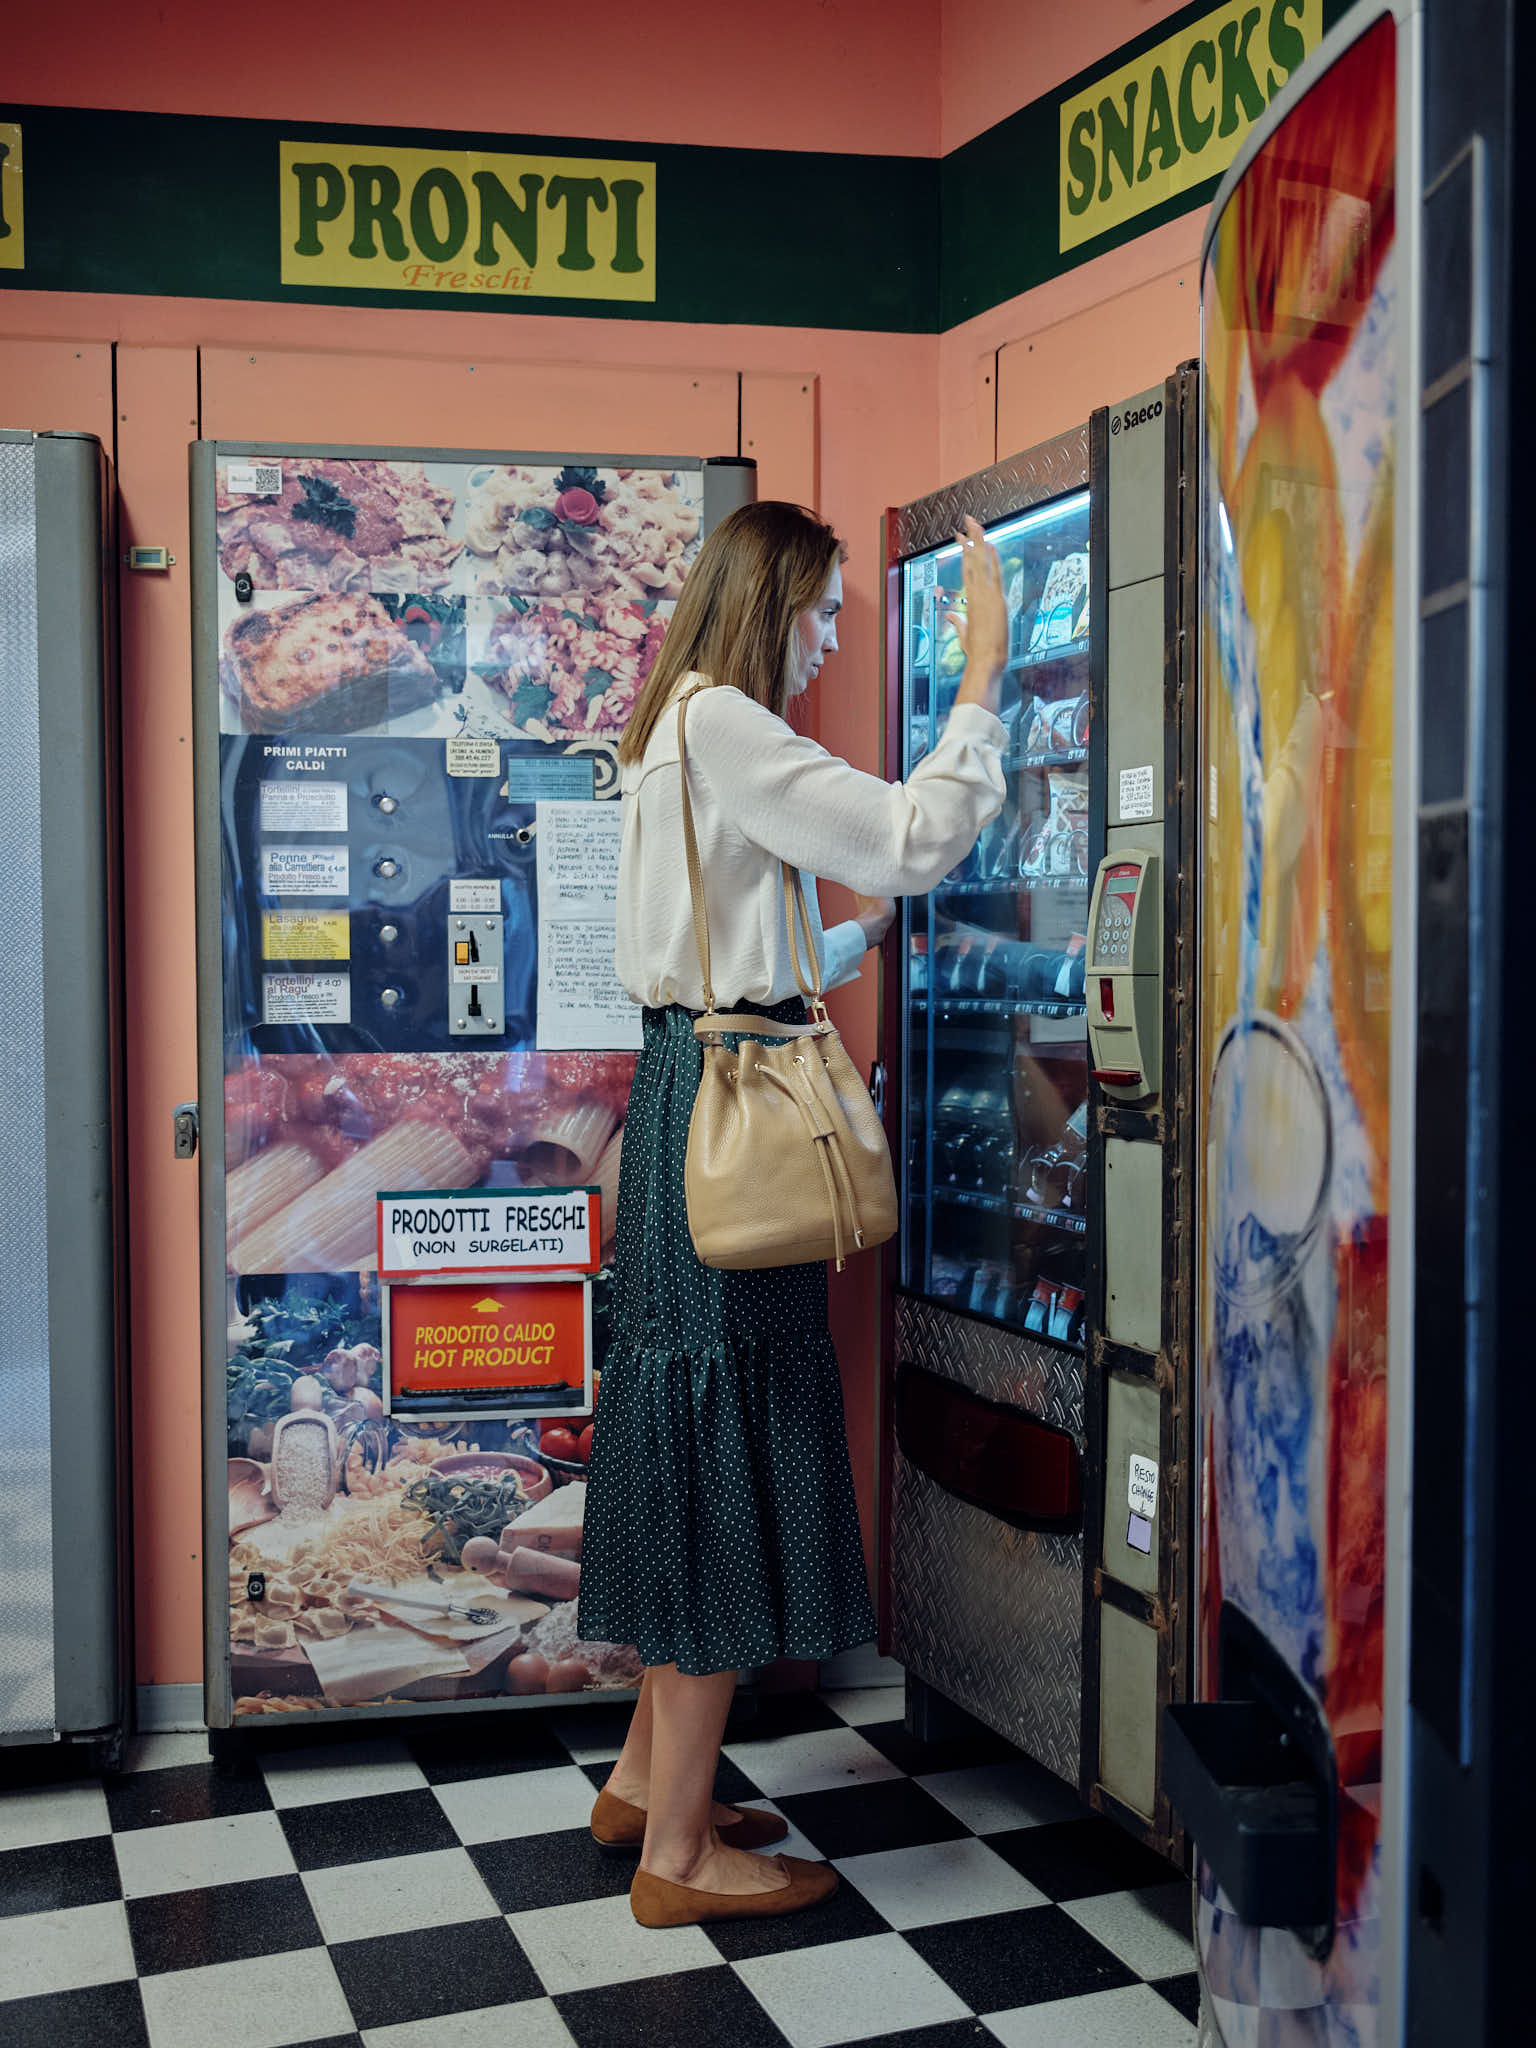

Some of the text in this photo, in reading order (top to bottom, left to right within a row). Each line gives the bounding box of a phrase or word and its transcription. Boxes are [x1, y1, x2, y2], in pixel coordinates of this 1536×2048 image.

[1067, 0, 1305, 216] SNACKS
[292, 162, 644, 273] PRONTI
[402, 264, 534, 290] Freschi
[1124, 400, 1163, 431] Saeco
[263, 746, 347, 757] PRIMI PIATTI
[286, 760, 325, 771] CALDI
[270, 852, 307, 864] Penne
[269, 911, 319, 926] Lasagne
[267, 975, 315, 986] Tortellini
[267, 986, 277, 994] al
[392, 1205, 586, 1234] PRODOTTI FRESCHI
[412, 1237, 564, 1256] (NON SURGELATI)
[415, 1322, 556, 1345] PRODOTTO CALDO
[413, 1346, 555, 1369] HOT PRODUCT
[1134, 1463, 1155, 1483] RESTO
[1131, 1483, 1154, 1504] CHANGE
